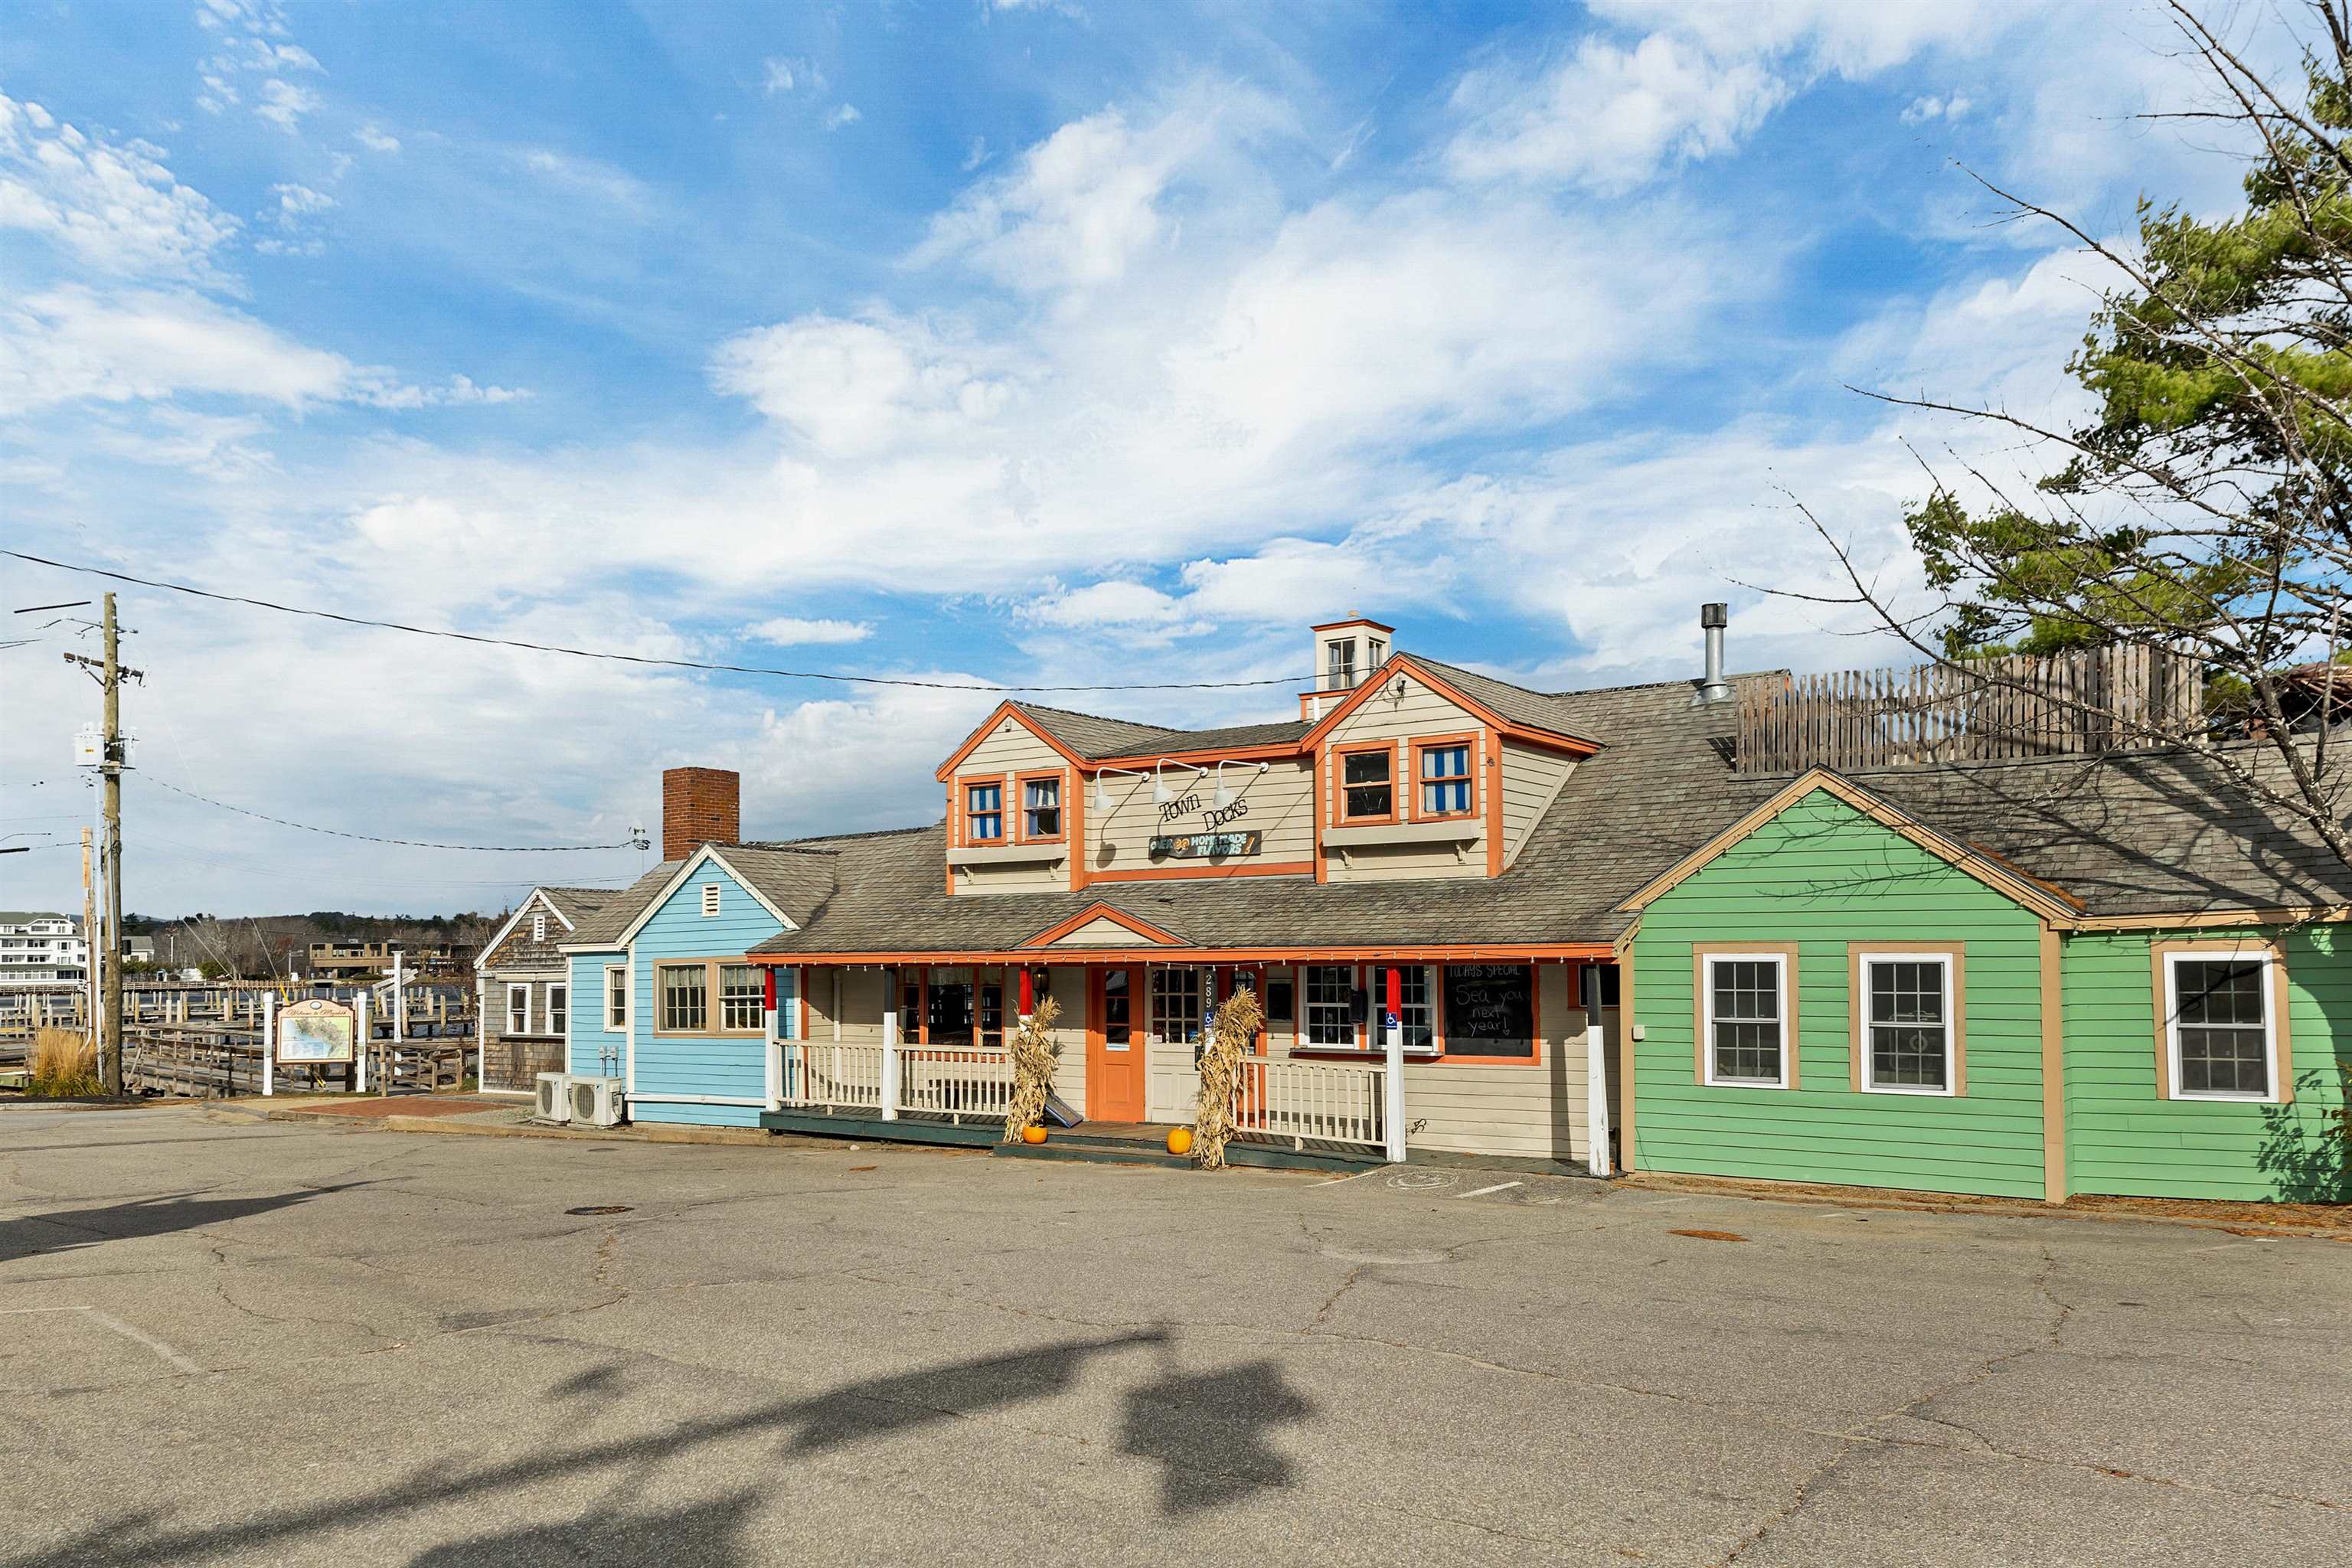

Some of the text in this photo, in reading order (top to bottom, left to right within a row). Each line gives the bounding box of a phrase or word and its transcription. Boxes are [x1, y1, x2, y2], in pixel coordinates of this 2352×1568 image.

[1158, 793, 1202, 822] Town
[1201, 799, 1248, 831] Docks
[1191, 833, 1246, 846] HOMEMADE
[1456, 985, 1524, 1010] Sea you
[1472, 1004, 1501, 1018] next
